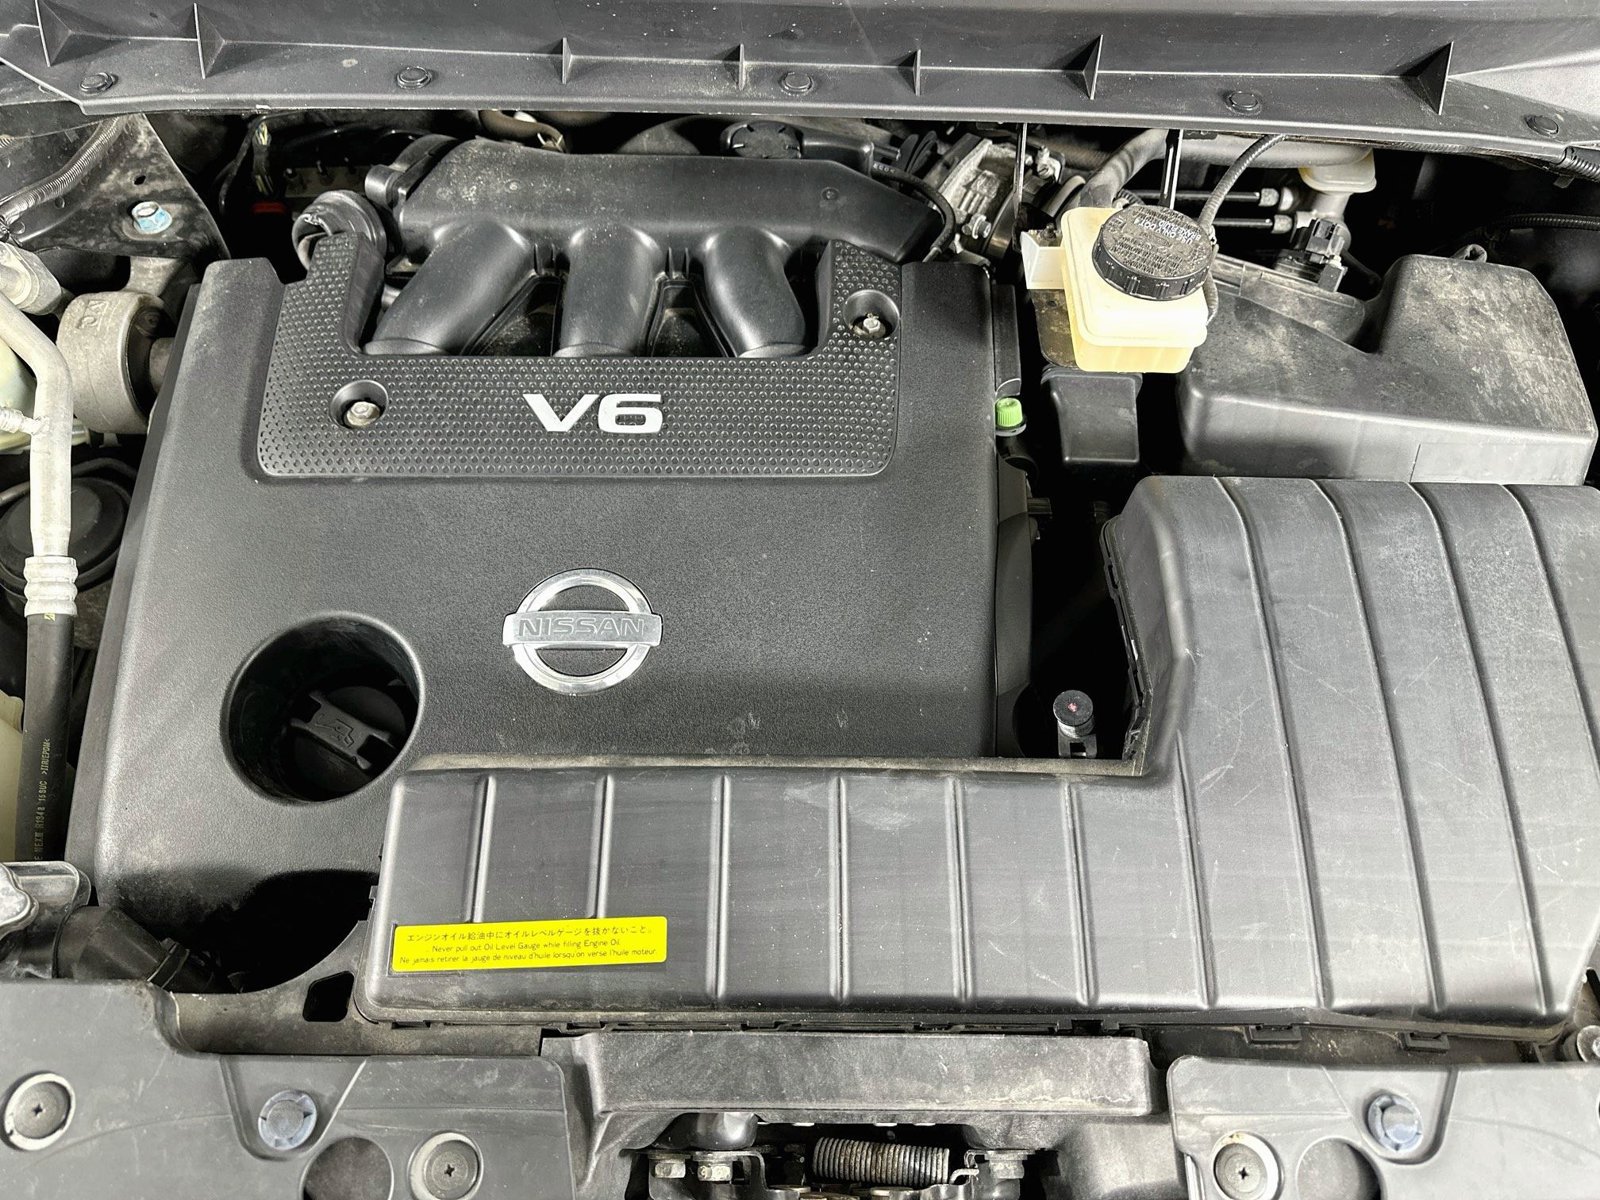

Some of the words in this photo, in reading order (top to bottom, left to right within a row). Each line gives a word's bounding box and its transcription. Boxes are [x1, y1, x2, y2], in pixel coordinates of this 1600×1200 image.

[1139, 221, 1156, 232] DOT
[1155, 226, 1177, 240] ONLY
[1158, 219, 1180, 233] FLUID
[1177, 234, 1194, 245] USE
[1179, 226, 1202, 241] BRAKE
[522, 393, 663, 434] V6
[518, 618, 645, 637] NISSAN
[432, 944, 453, 953] Never
[456, 944, 468, 953] pull
[470, 944, 481, 952] out
[484, 943, 494, 951] Oil
[496, 942, 516, 951] Level
[518, 941, 541, 952] Gauge
[543, 940, 561, 949] while
[563, 939, 582, 949] filling
[584, 939, 608, 949] Engine
[399, 956, 410, 964] Ne
[412, 956, 435, 966] jamais
[437, 955, 460, 963] retirer
[462, 954, 469, 962] la
[471, 954, 490, 964] jauge
[493, 953, 502, 962] de
[503, 952, 527, 961] niveau
[588, 950, 608, 958] verse
